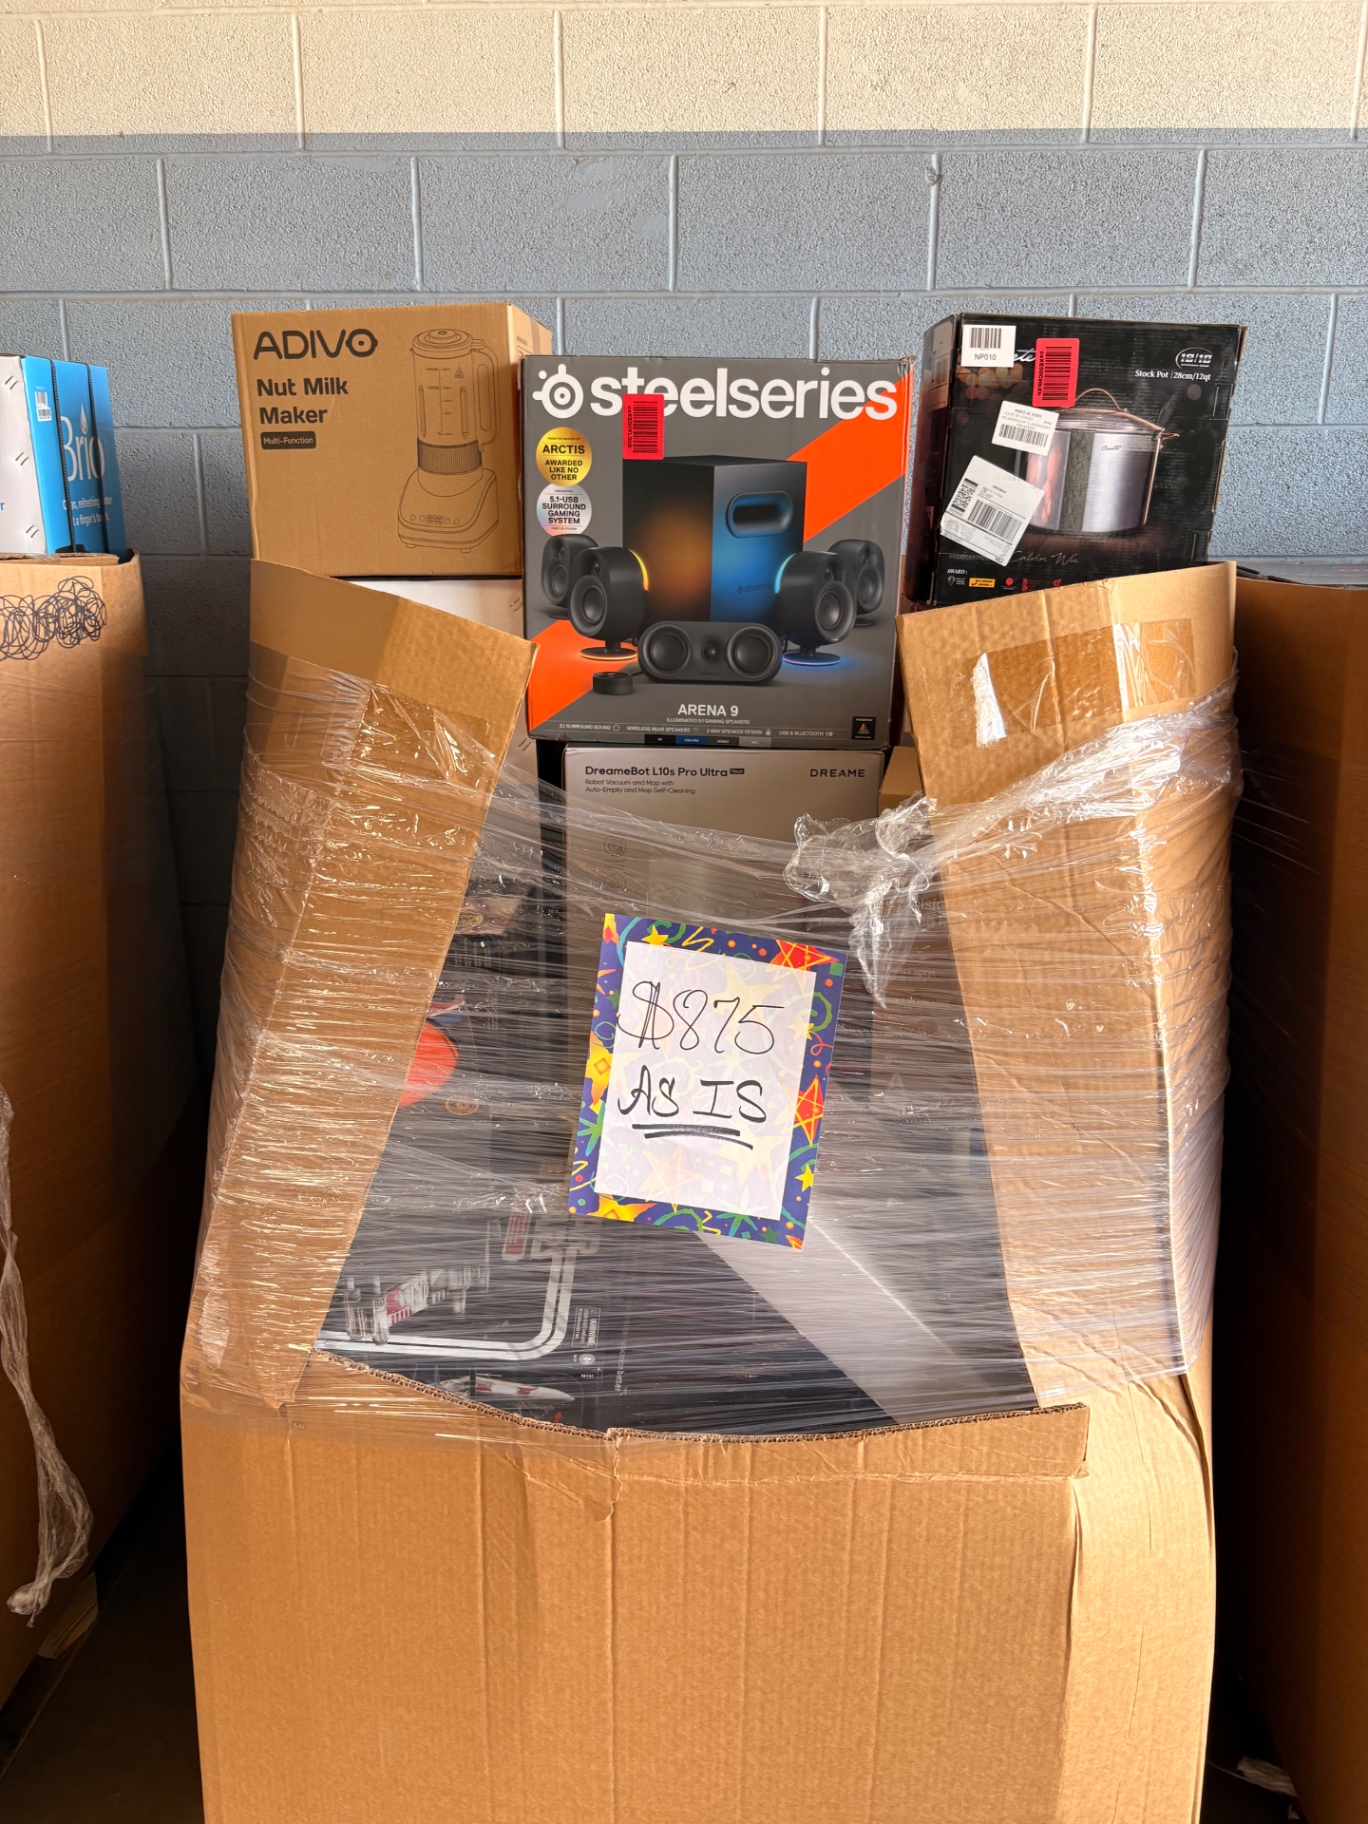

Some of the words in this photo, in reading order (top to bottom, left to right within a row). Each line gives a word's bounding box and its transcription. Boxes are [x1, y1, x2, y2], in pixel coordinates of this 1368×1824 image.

[253, 328, 378, 360] ADIVO
[974, 353, 997, 361] NP010
[1134, 369, 1155, 378] Stock
[1156, 370, 1169, 379] Pot
[257, 378, 297, 396] Nut
[303, 377, 349, 396] Milk
[259, 406, 328, 425] Maker
[263, 436, 314, 446] Multi-Function
[60, 415, 105, 482] Brio
[542, 444, 585, 455] ARCTIS
[545, 459, 583, 467] AWARDED
[549, 466, 566, 474] LIKE
[541, 503, 587, 511] SURROUND
[548, 510, 581, 518] GAMING
[548, 517, 581, 525] SYSTEM
[677, 703, 727, 717] ARENA
[730, 705, 739, 717] 9
[585, 766, 650, 776] DreameBot
[652, 767, 676, 776] L10s
[677, 767, 698, 777] Pro
[700, 767, 728, 777] Ultra
[810, 768, 866, 778] DREAME
[585, 786, 623, 794] Auto-Empty
[653, 787, 696, 795] Self-Cleaning
[616, 980, 786, 1055] $875
[617, 1064, 680, 1118] AS
[692, 1078, 768, 1123] IS
